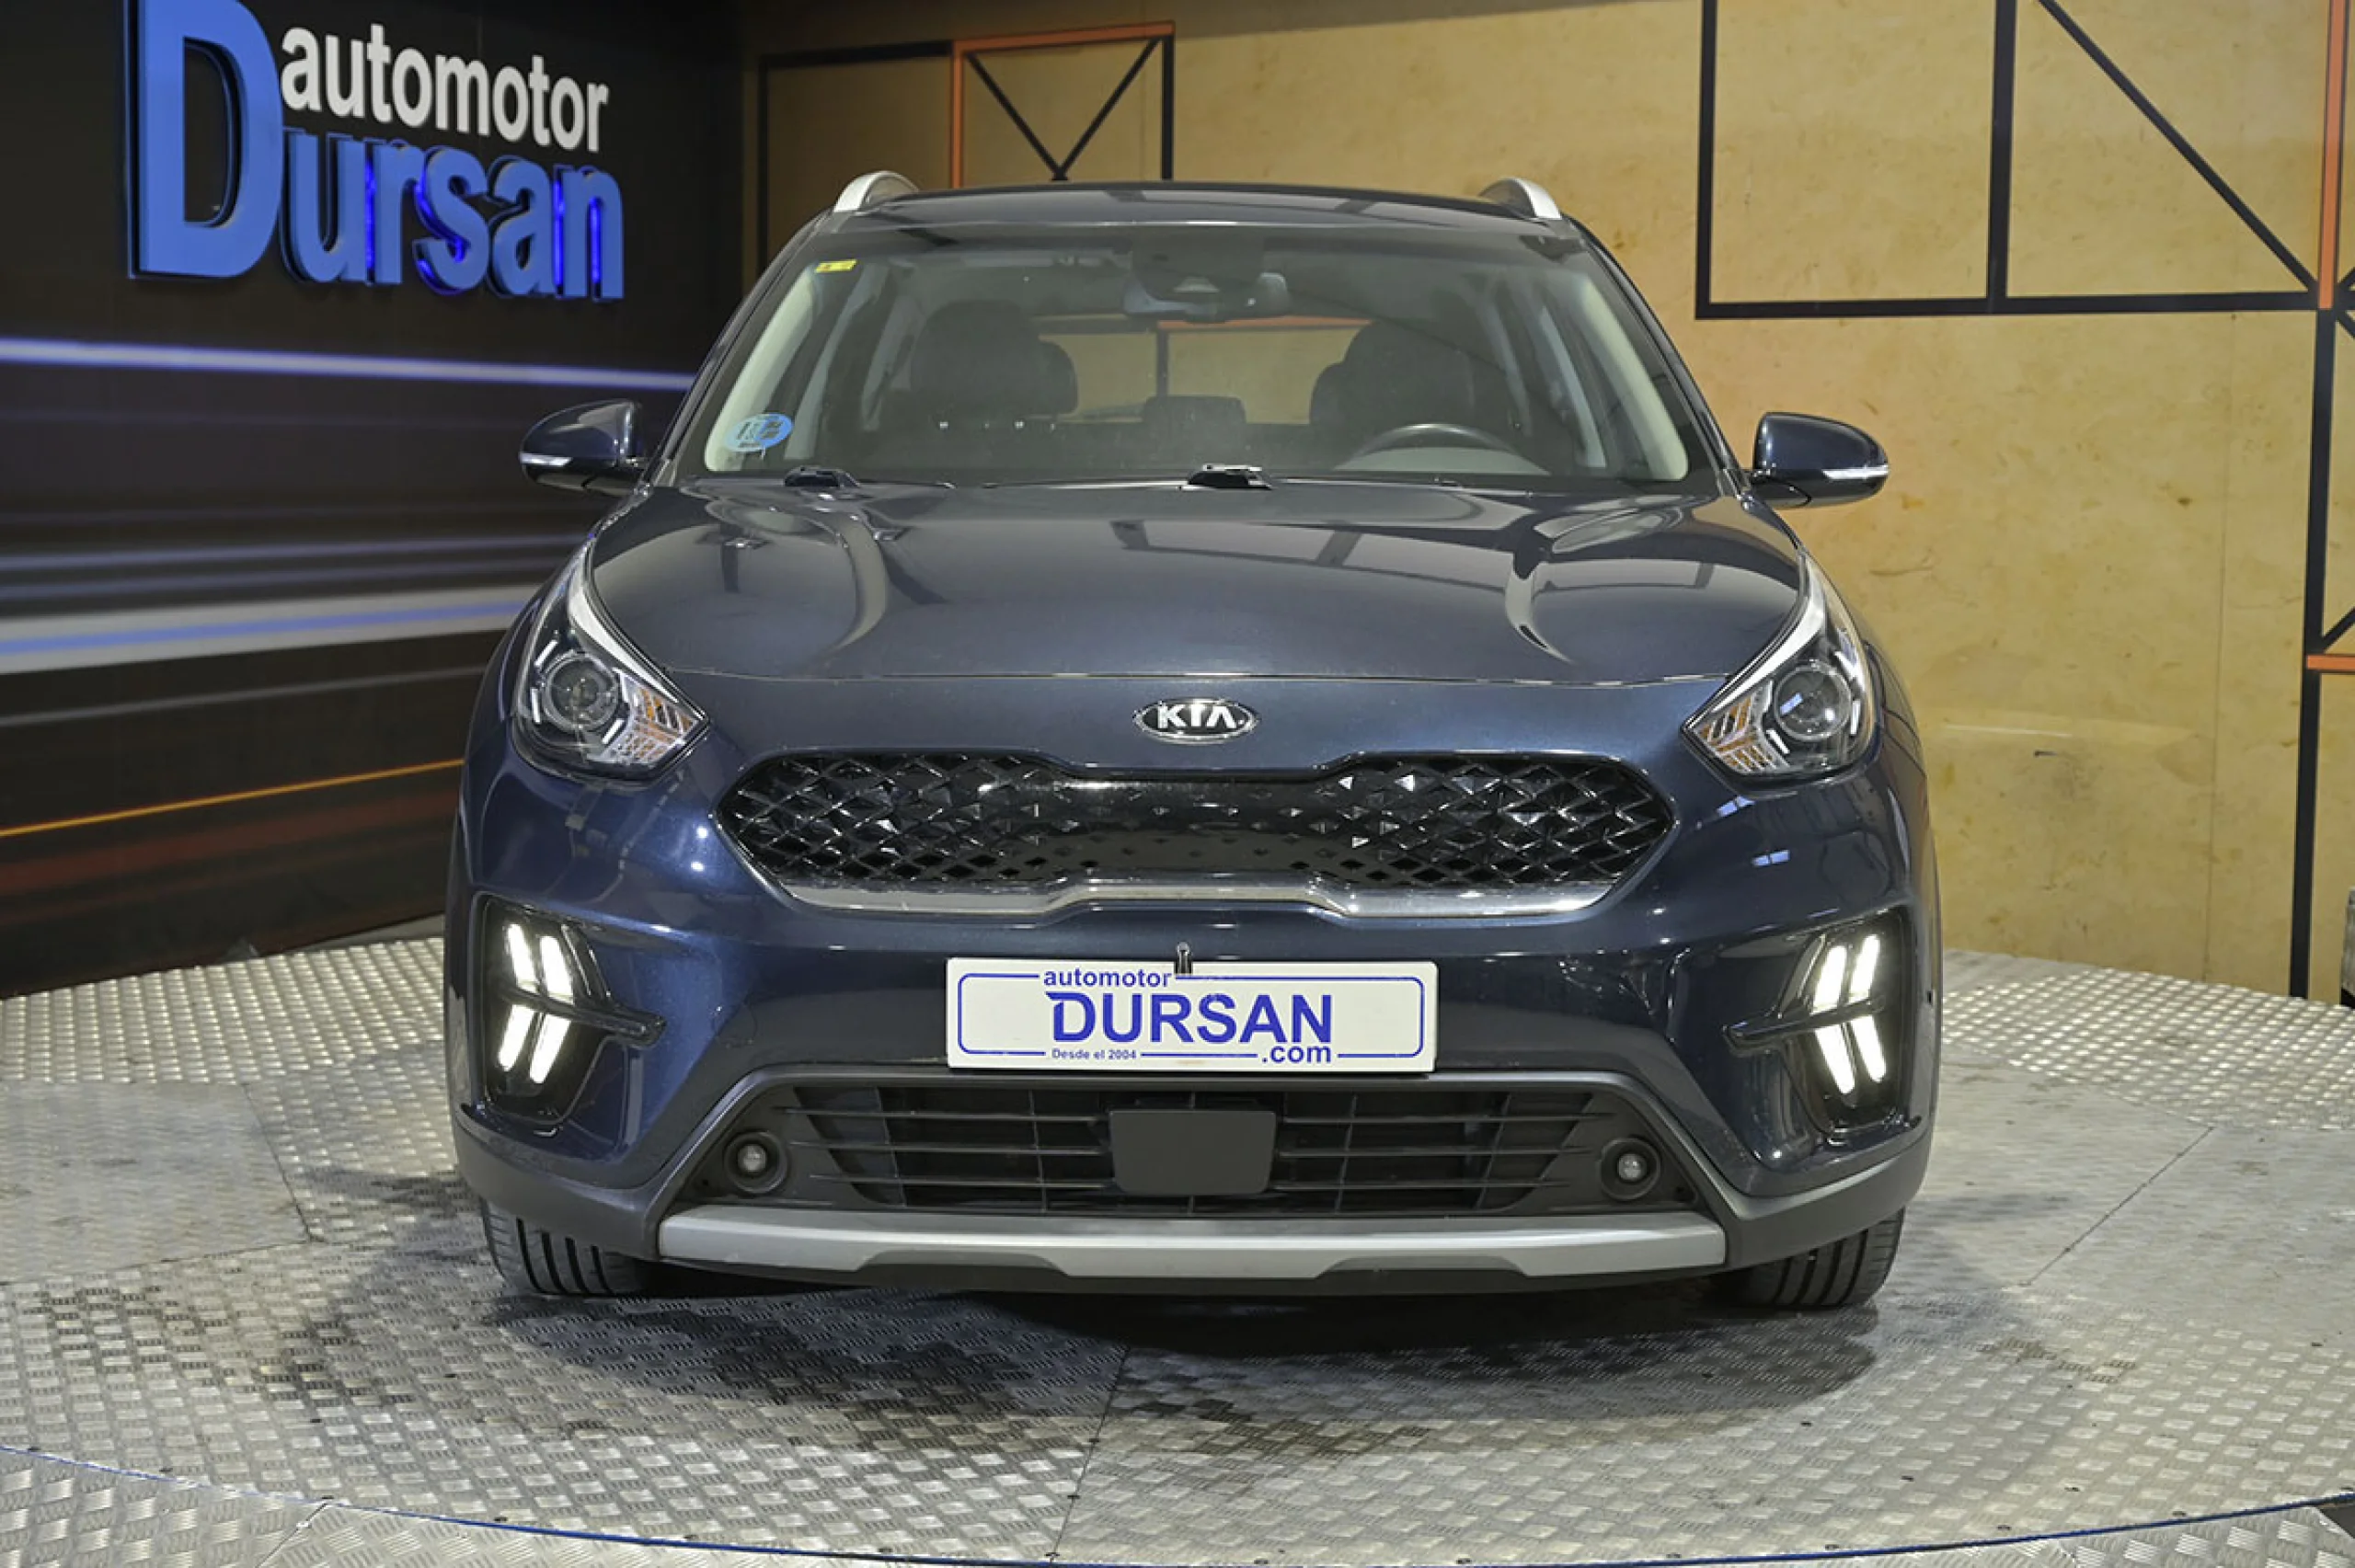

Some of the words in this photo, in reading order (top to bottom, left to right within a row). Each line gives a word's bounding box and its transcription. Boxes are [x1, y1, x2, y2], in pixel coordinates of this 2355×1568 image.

[281, 23, 609, 152] automotor
[129, 0, 625, 300] Dursan
[1157, 704, 1237, 729] KIA
[1043, 967, 1173, 988] automotor
[1045, 991, 1332, 1043] DURSAN
[1051, 1047, 1090, 1059] Desde
[1093, 1048, 1105, 1059] el
[1108, 1049, 1137, 1060] 2004
[1262, 1045, 1332, 1064] .com
